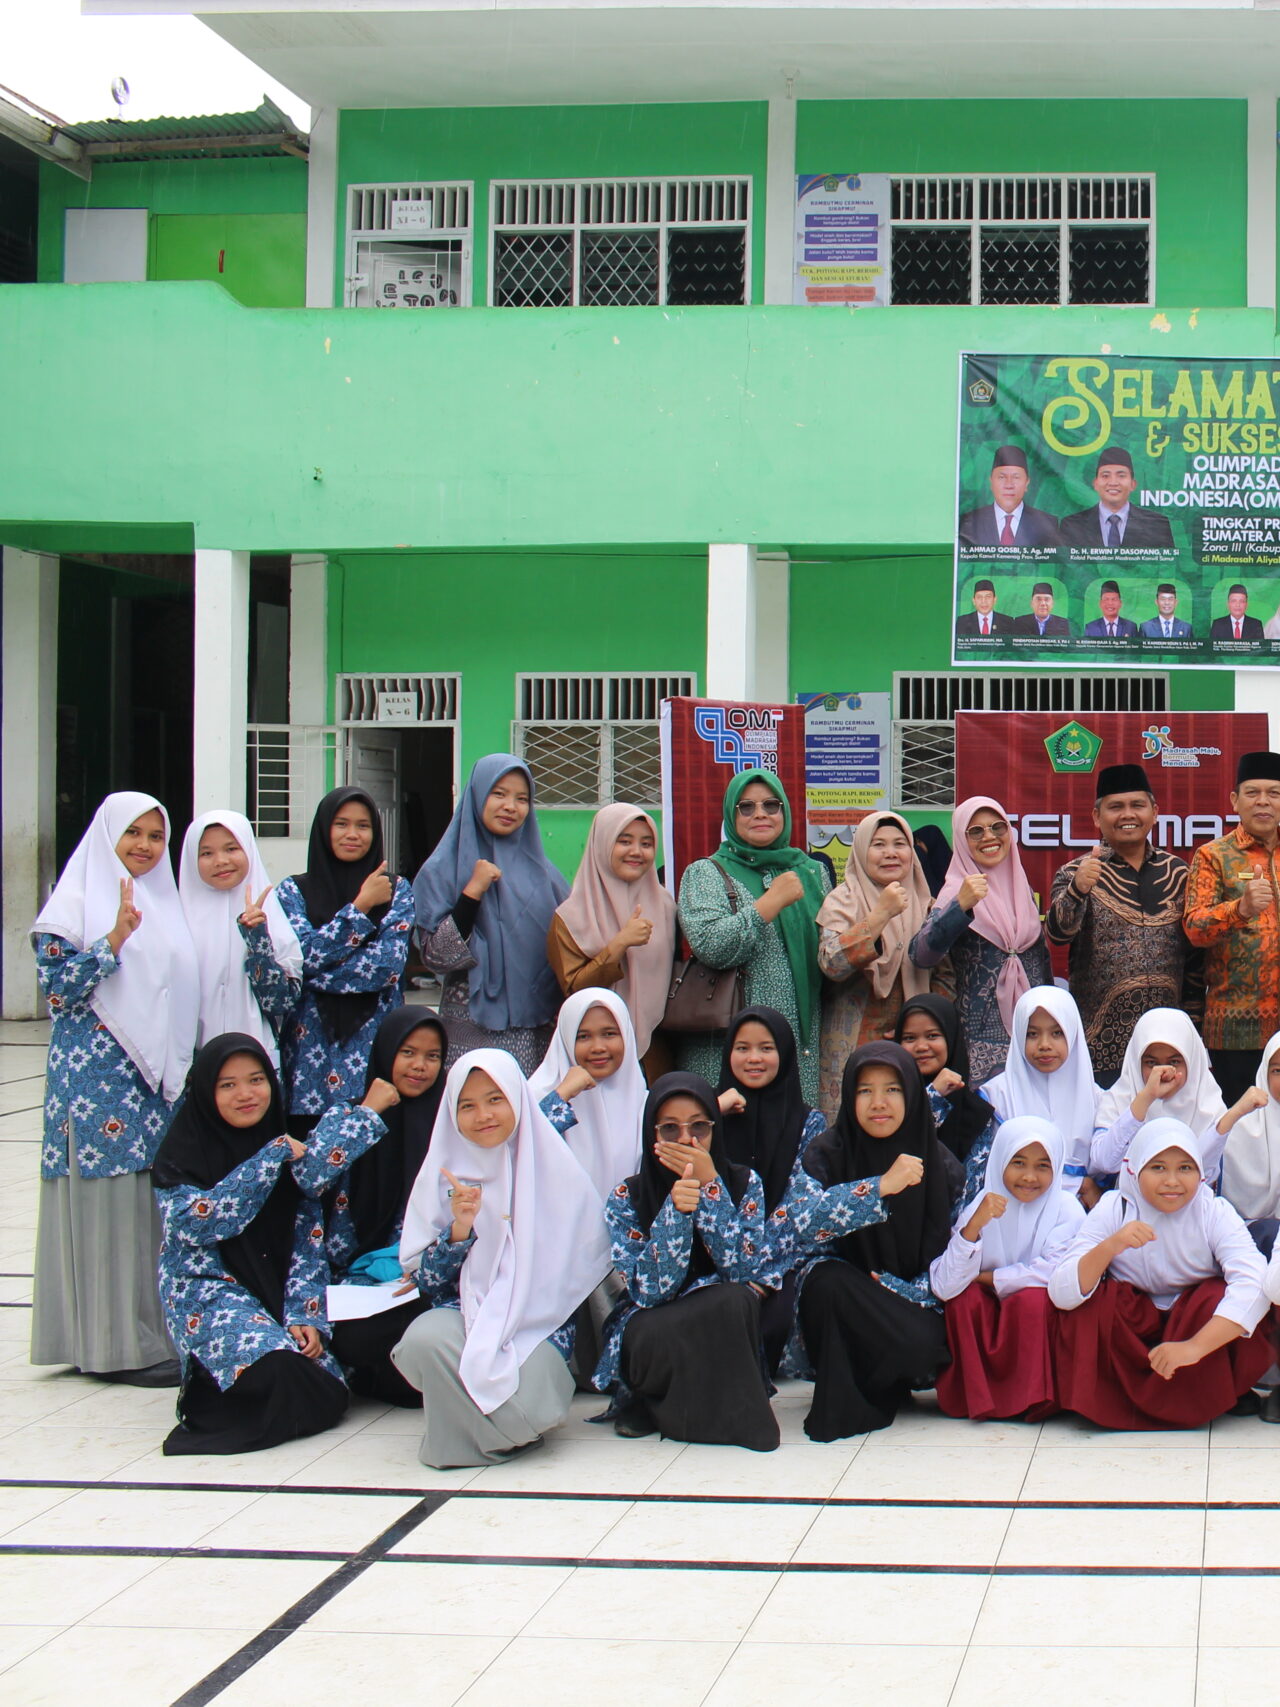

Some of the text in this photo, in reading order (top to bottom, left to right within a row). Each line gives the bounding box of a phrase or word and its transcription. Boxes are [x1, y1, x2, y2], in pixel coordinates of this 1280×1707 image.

[1146, 421, 1170, 457] &
[1202, 517, 1262, 531] TINGKAT
[1202, 530, 1273, 543] SUMATERA
[997, 546, 1021, 555] QOSBI,
[1202, 542, 1228, 552] Zona
[1231, 542, 1242, 552] III
[1201, 555, 1210, 563] di
[1211, 555, 1254, 564] Madrasah
[1200, 747, 1221, 755] Maju,
[762, 753, 776, 763] 20
